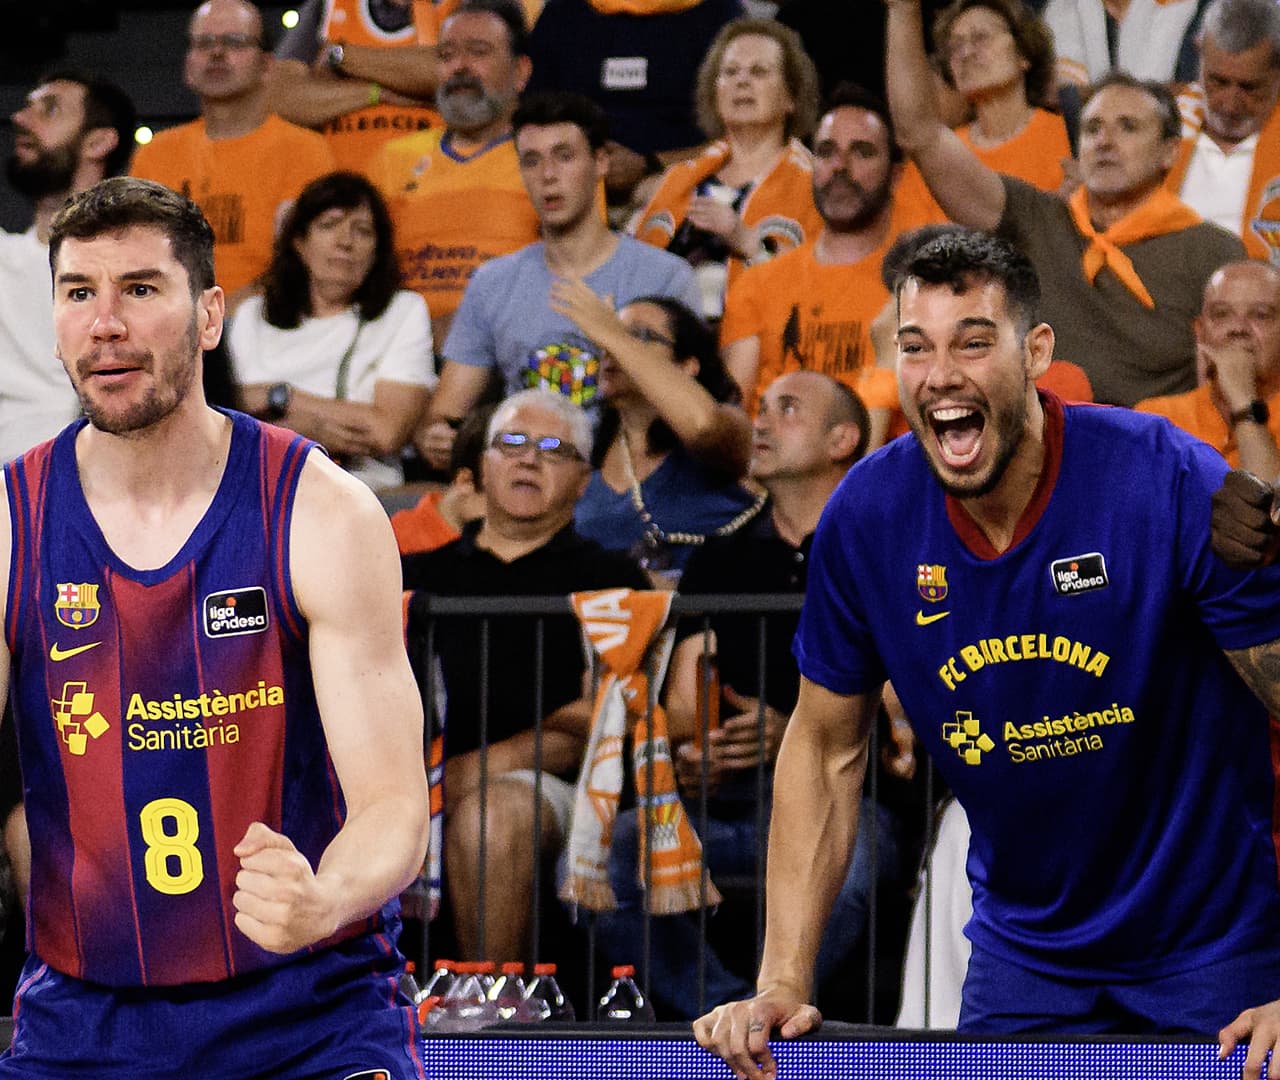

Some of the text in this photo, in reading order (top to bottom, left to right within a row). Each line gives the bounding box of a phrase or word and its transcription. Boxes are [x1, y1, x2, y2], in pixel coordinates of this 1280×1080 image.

[210, 606, 235, 620] liga
[211, 615, 265, 631] endesa
[938, 657, 967, 691] FC
[126, 680, 284, 721] Assistència
[127, 719, 240, 751] Sanitària
[1004, 703, 1136, 741] Assistència
[1008, 732, 1104, 763] Sanitària
[139, 797, 204, 895] 8
